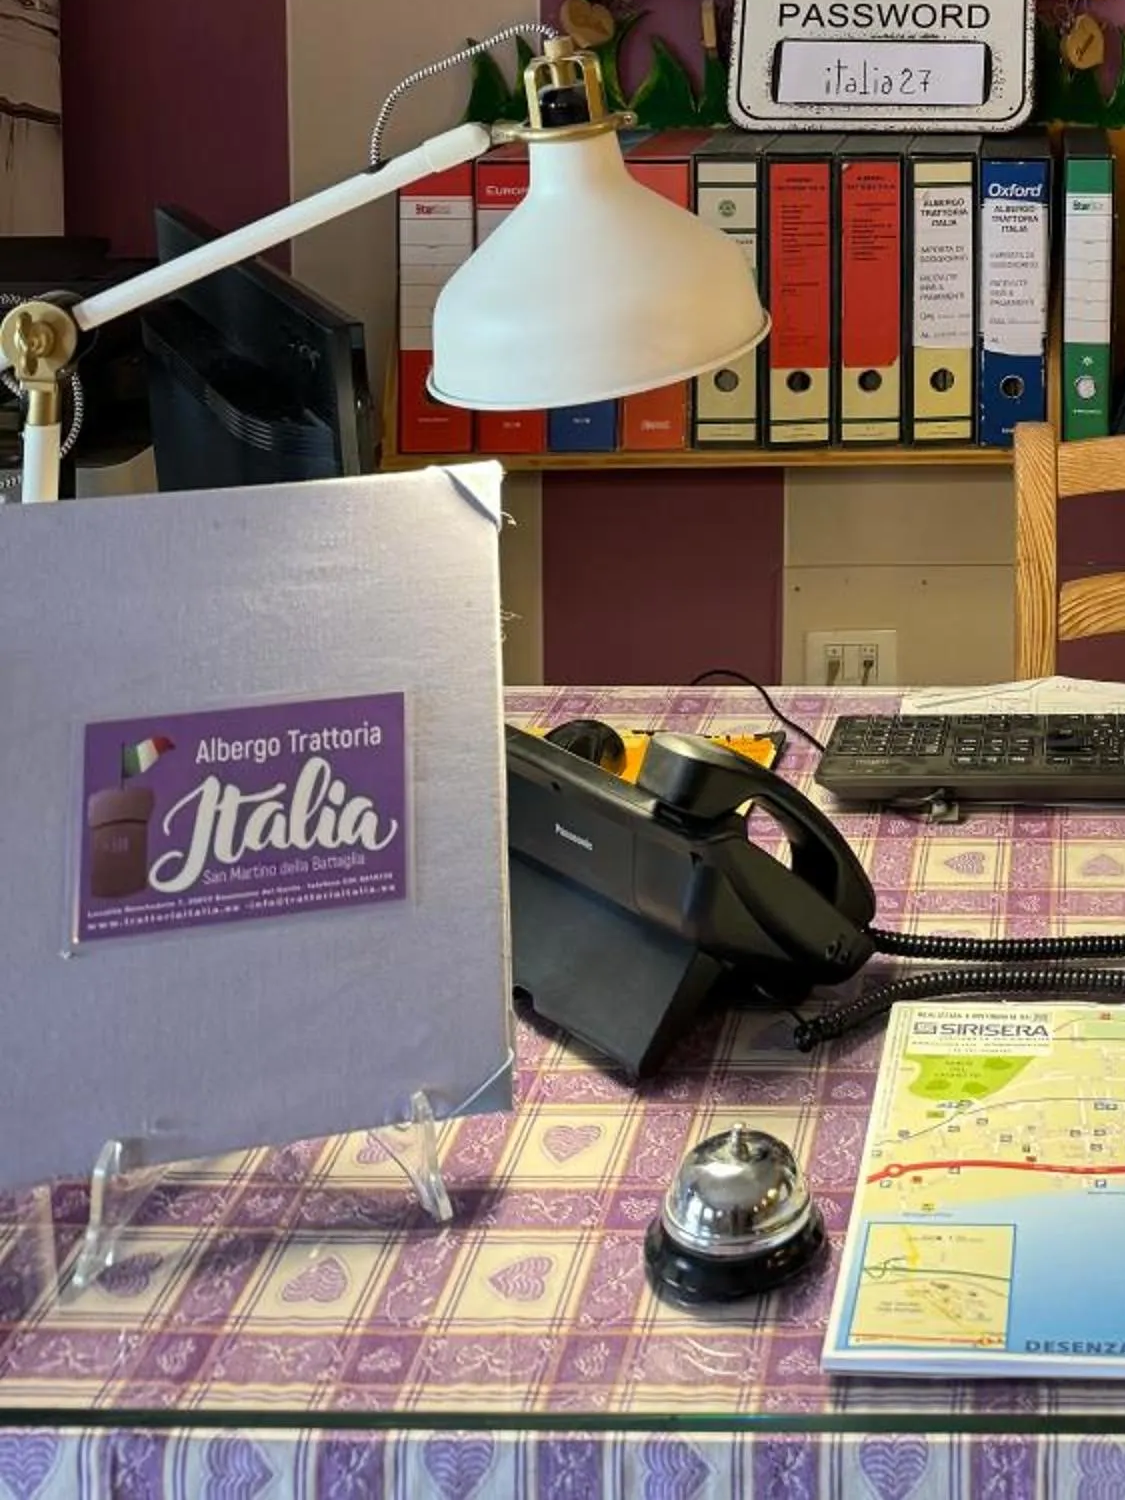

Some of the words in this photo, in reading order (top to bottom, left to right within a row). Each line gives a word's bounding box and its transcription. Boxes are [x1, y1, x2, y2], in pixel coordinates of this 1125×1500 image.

[778, 2, 991, 29] PASSWORD
[988, 182, 1042, 198] Oxford
[923, 198, 965, 207] ALBERGO
[993, 205, 1036, 214] ALBERGO
[920, 208, 969, 217] TRATTORIA
[991, 215, 1039, 224] TRATTORIA
[195, 735, 281, 765] Albergo
[287, 720, 382, 754] Trattoria
[149, 756, 398, 894] Italia
[202, 868, 227, 885] San
[230, 864, 277, 881] Martino
[279, 860, 309, 876] della
[312, 851, 366, 872] Battaglia
[939, 1023, 1050, 1037] SIRISERA
